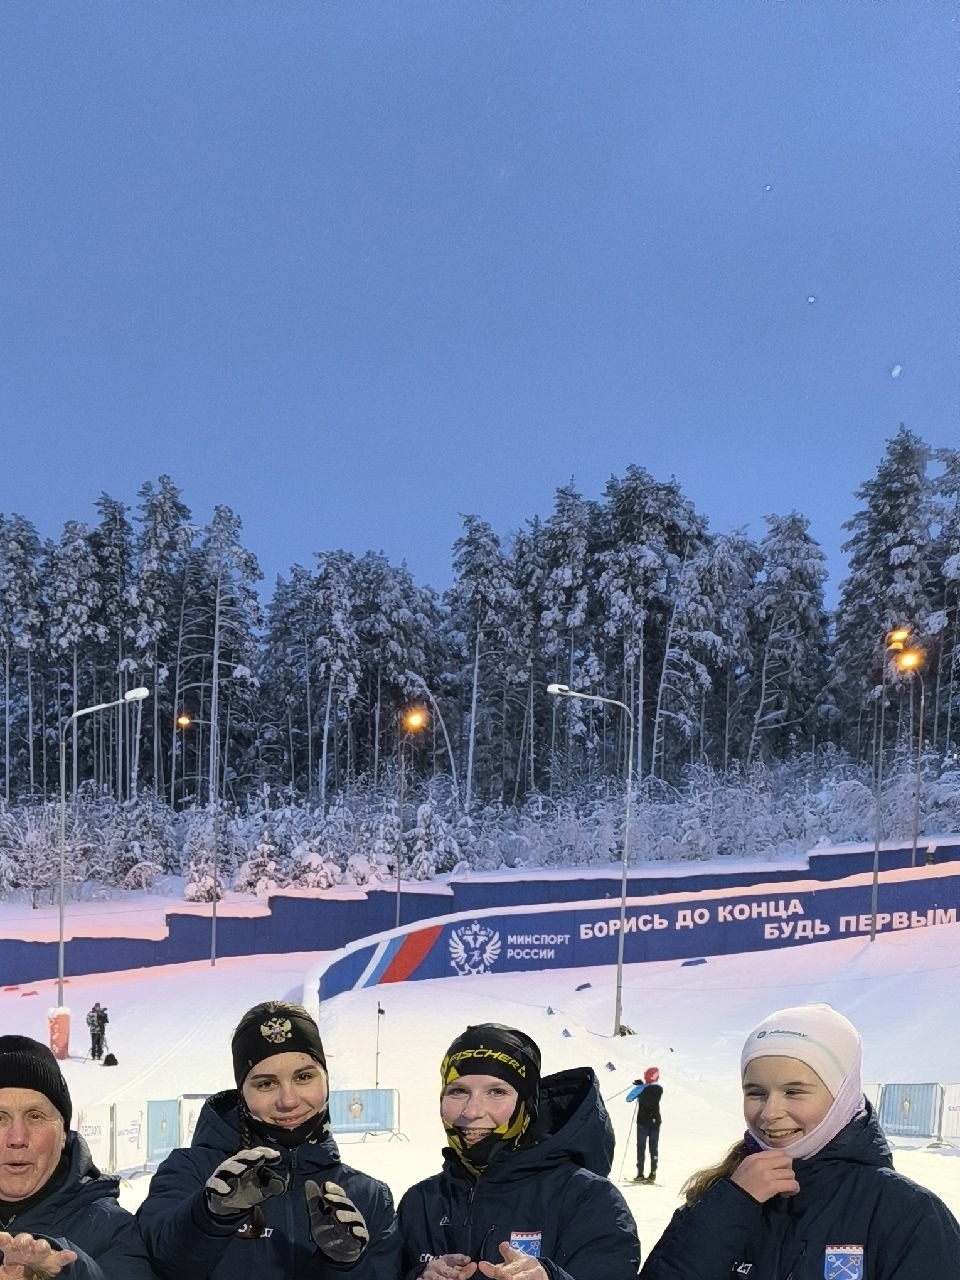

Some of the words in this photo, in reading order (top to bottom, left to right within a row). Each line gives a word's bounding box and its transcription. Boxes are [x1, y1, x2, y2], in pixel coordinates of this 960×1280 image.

[579, 914, 669, 940] БОРИСЬ
[675, 909, 710, 930] ДО
[717, 899, 805, 923] КОНЦА
[764, 919, 831, 940] БУДЬ
[839, 908, 956, 933] ПЕРВЫМ
[507, 934, 571, 946] МИНСПОРТ
[507, 949, 555, 960] РОССИИ
[449, 1049, 520, 1070] FISCHER
